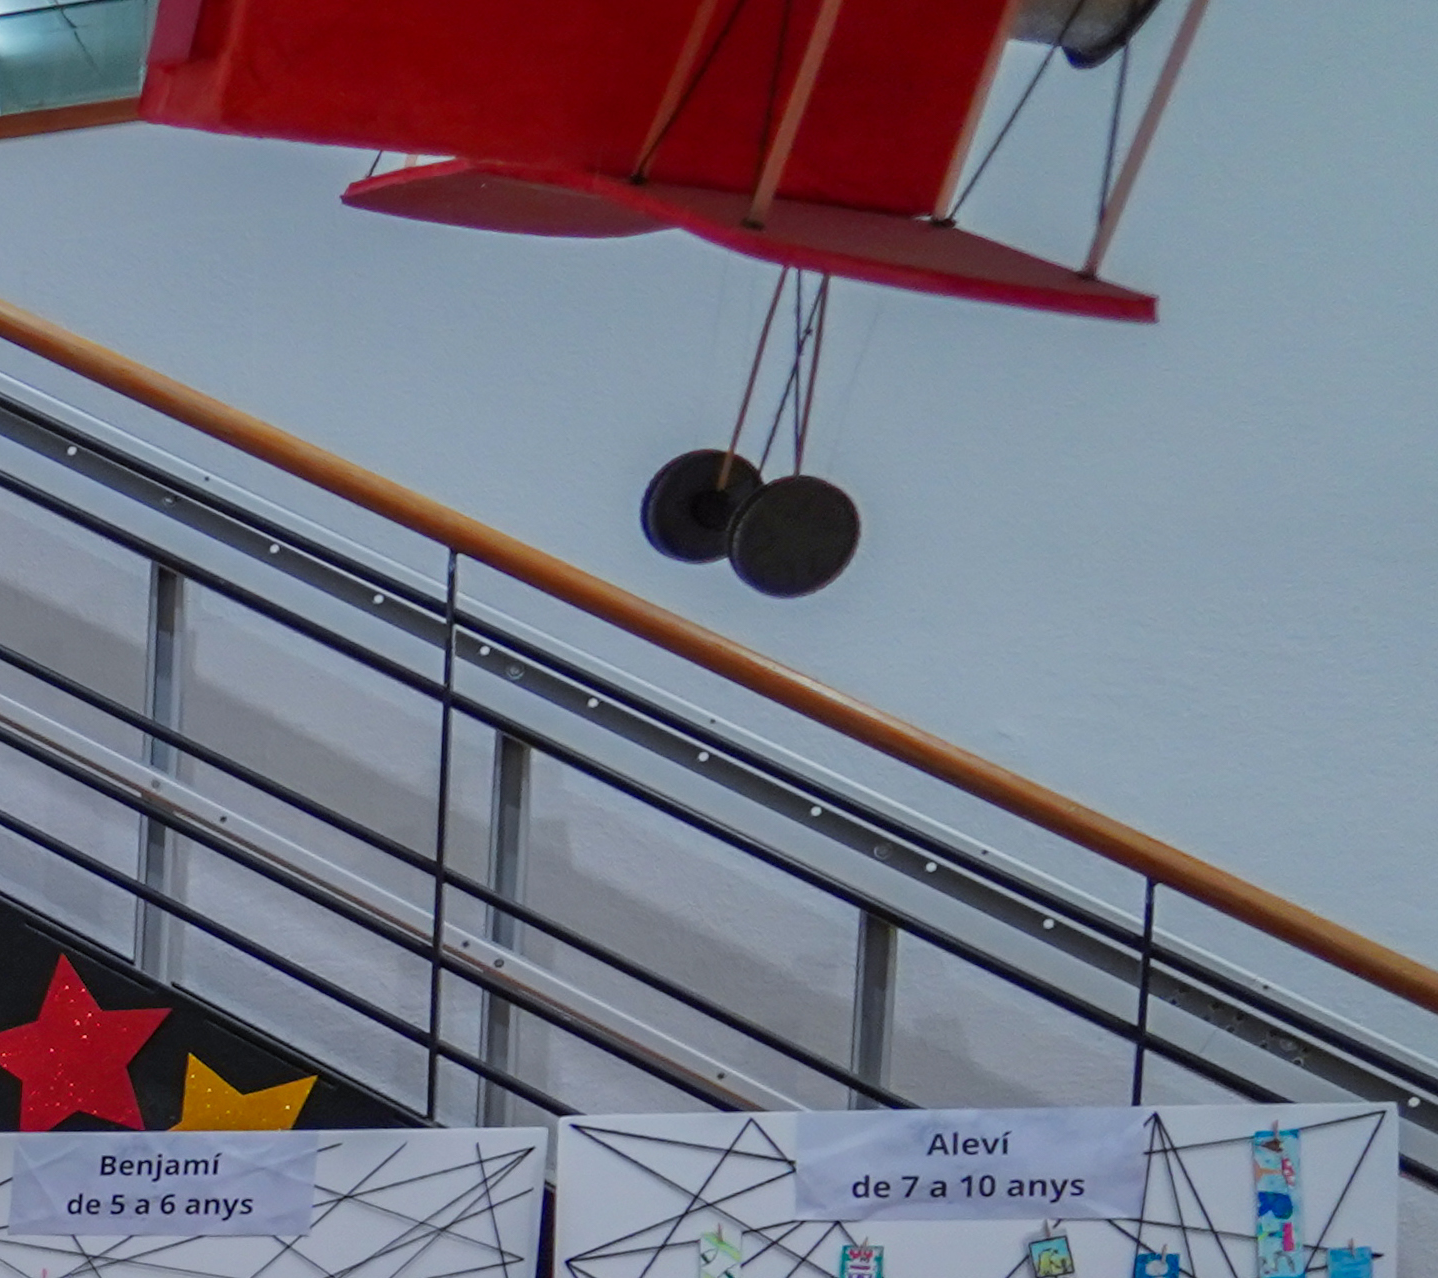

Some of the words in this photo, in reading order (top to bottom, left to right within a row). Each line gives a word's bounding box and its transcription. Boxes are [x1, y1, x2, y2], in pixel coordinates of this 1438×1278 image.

[927, 1132, 1010, 1155] Aleví
[100, 1153, 221, 1182] Benjamí
[852, 1175, 890, 1198] de
[902, 1176, 919, 1198] 7
[930, 1181, 946, 1198] a
[961, 1175, 995, 1197] 10
[1007, 1179, 1084, 1203] anys
[68, 1194, 100, 1215] de
[111, 1195, 125, 1214] 5
[135, 1199, 149, 1215] a
[161, 1194, 175, 1214] 6
[185, 1199, 253, 1221] anys
